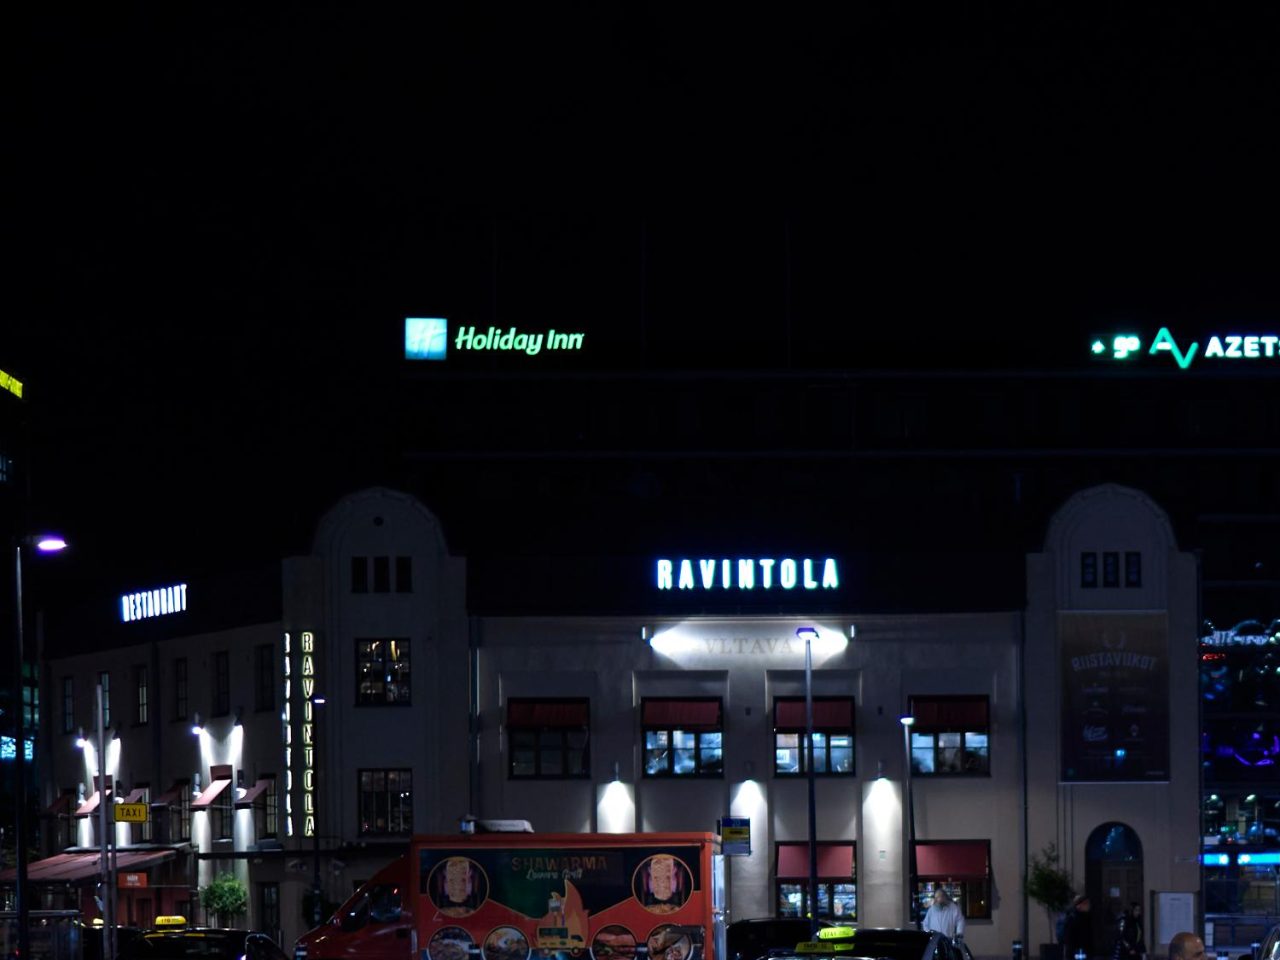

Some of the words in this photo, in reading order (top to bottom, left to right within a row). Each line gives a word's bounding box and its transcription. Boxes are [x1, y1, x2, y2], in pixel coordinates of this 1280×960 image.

[455, 326, 543, 355] Holiday
[546, 329, 583, 350] Inn
[656, 558, 840, 590] RAVINTOLA
[120, 807, 142, 818] TAXI
[511, 855, 608, 872] SHAWARMA
